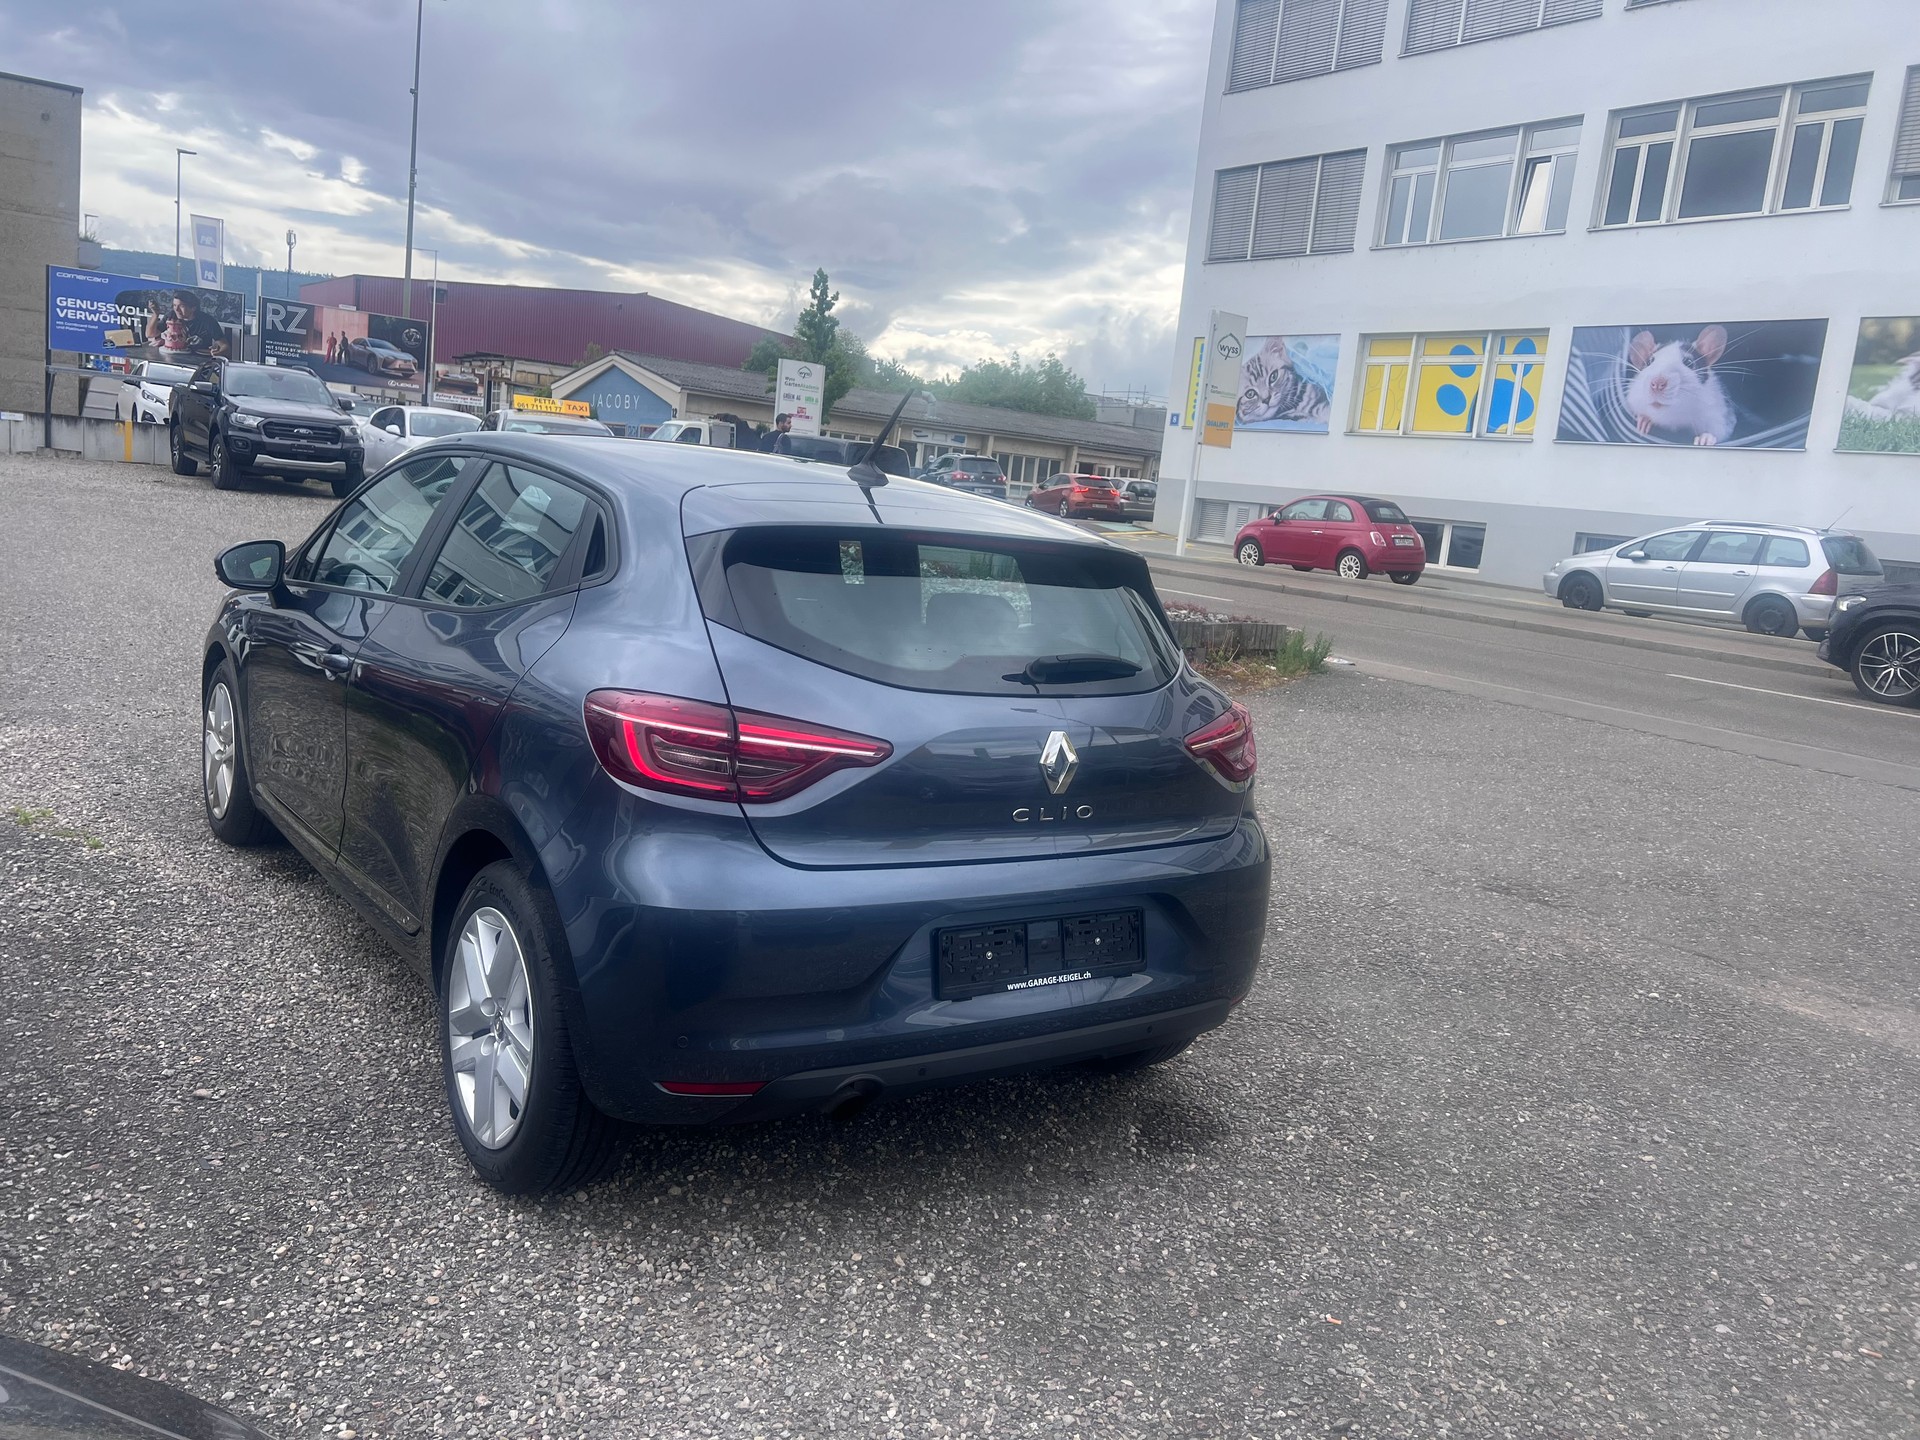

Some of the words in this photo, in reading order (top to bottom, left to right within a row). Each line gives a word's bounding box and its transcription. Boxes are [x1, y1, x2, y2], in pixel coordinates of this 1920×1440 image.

[56, 296, 152, 318] GENUSSVOLL
[56, 308, 142, 327] VERWÖHNT.
[265, 302, 308, 335] RZ
[1220, 344, 1238, 360] wyss
[534, 397, 556, 405] PETTA
[567, 404, 588, 412] TAXI
[591, 393, 640, 410] JACOBY
[1012, 805, 1094, 822] CLIO
[1007, 971, 1092, 990] www.GARAGE-KEIGEL.ch
